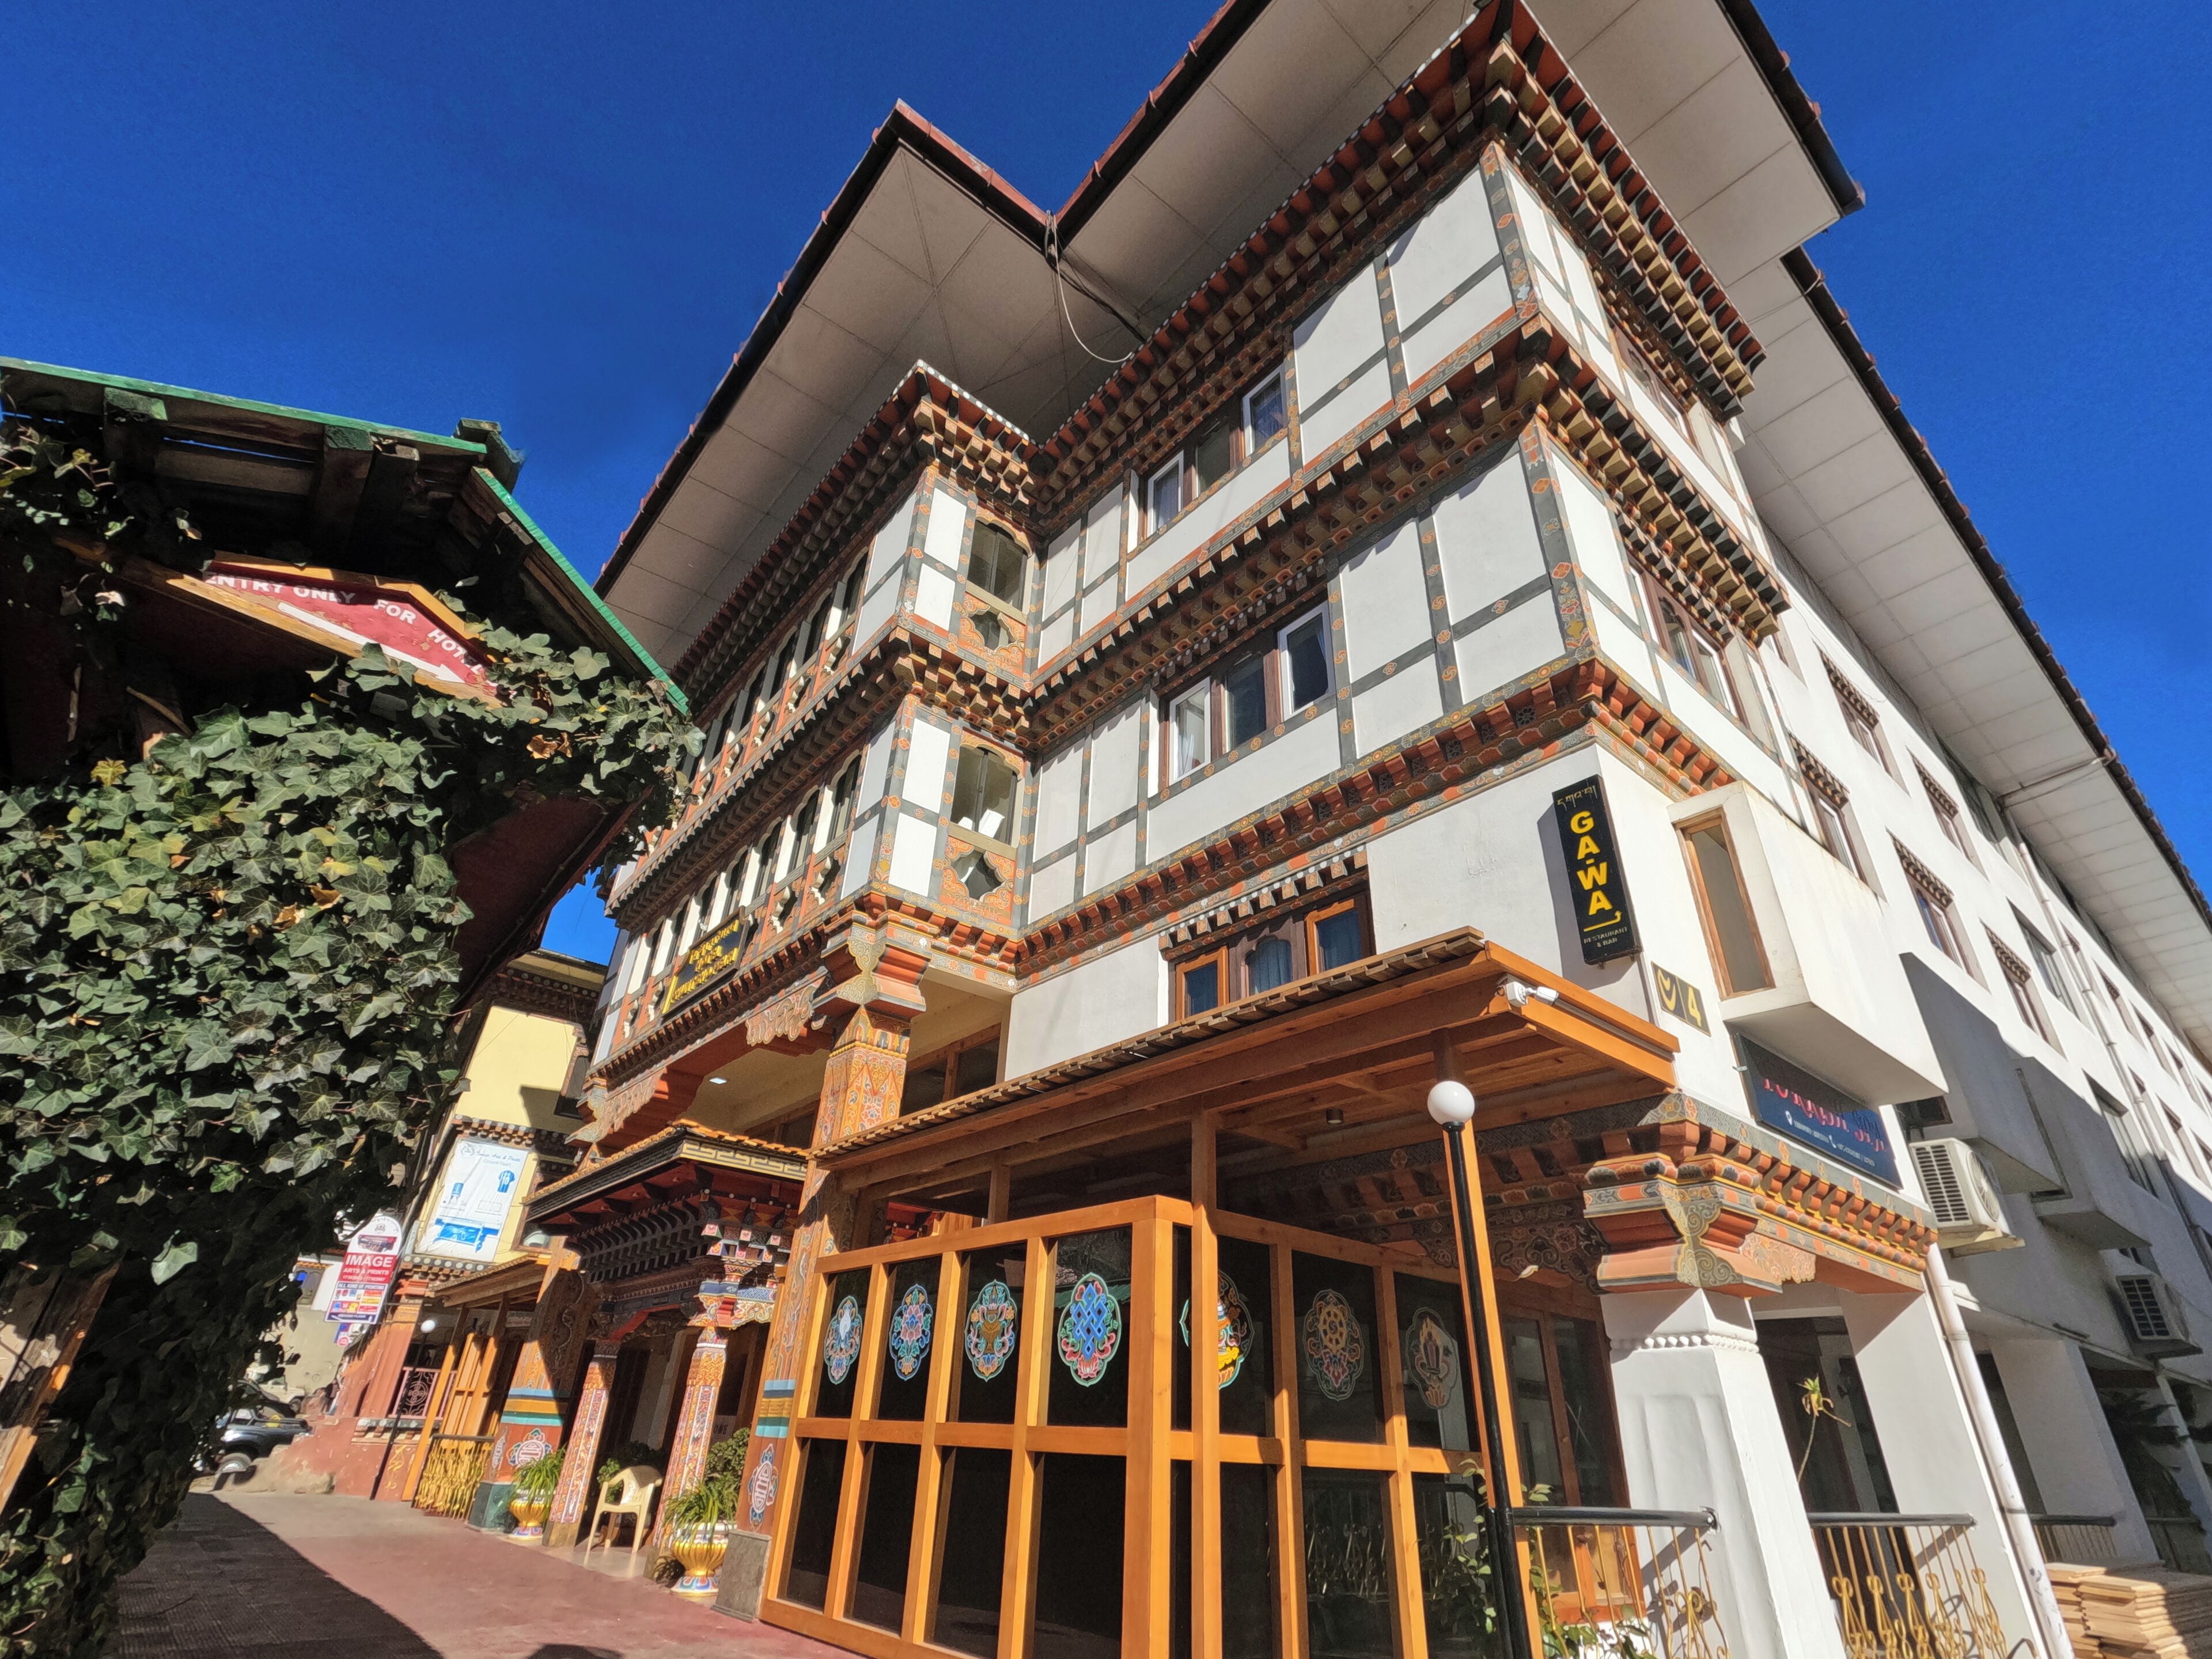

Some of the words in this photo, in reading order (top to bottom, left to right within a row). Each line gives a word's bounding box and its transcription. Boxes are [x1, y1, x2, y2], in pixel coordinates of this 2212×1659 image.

[204, 573, 286, 594] ENTRY
[292, 585, 357, 604] ONLY
[373, 599, 417, 625] FOR
[1583, 926, 1628, 944] RESTAURANT
[1603, 937, 1618, 946] BAR
[1688, 986, 1702, 1028] 4
[345, 1255, 393, 1268] IMAGE
